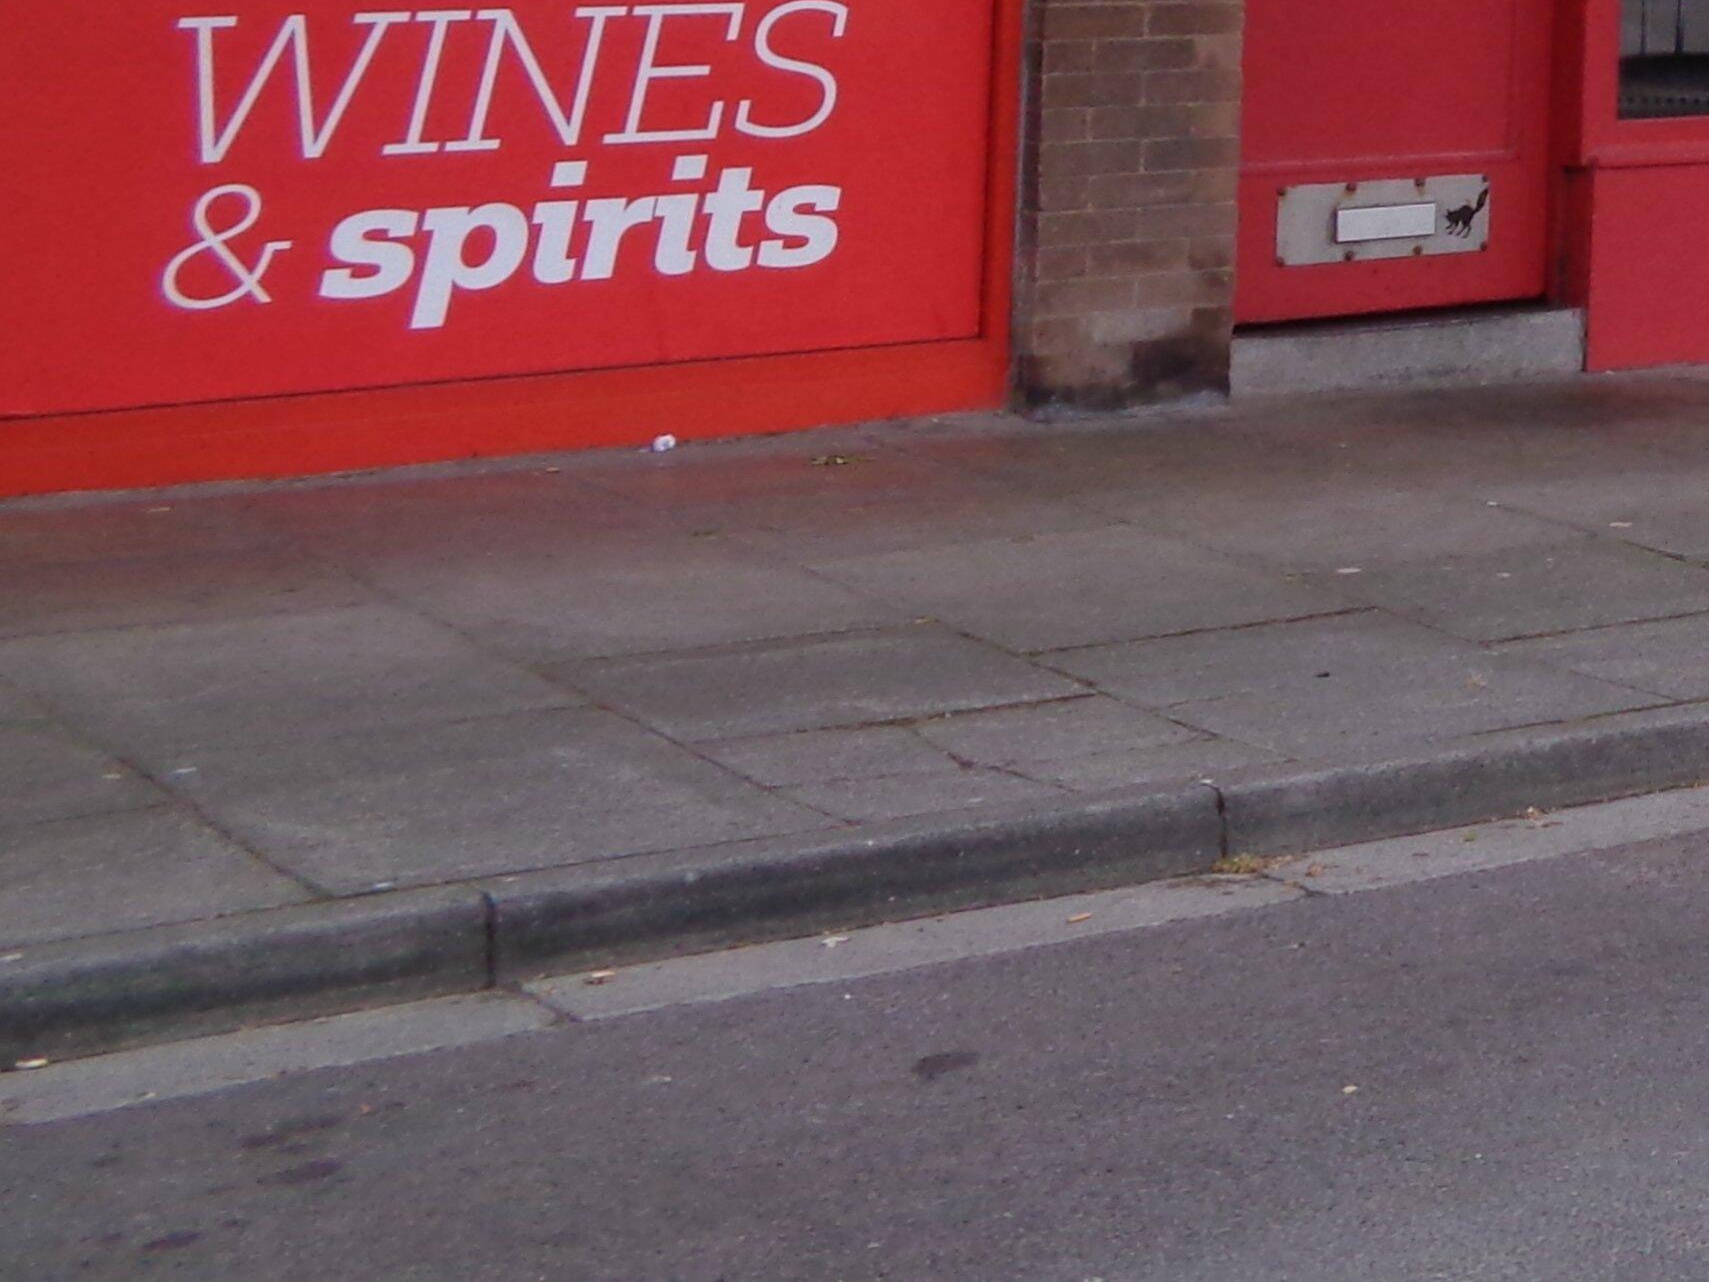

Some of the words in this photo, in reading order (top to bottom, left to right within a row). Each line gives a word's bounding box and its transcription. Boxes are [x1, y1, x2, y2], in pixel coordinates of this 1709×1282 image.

[178, 0, 849, 165] WINES
[161, 184, 292, 311] &
[318, 154, 843, 330] spirits
